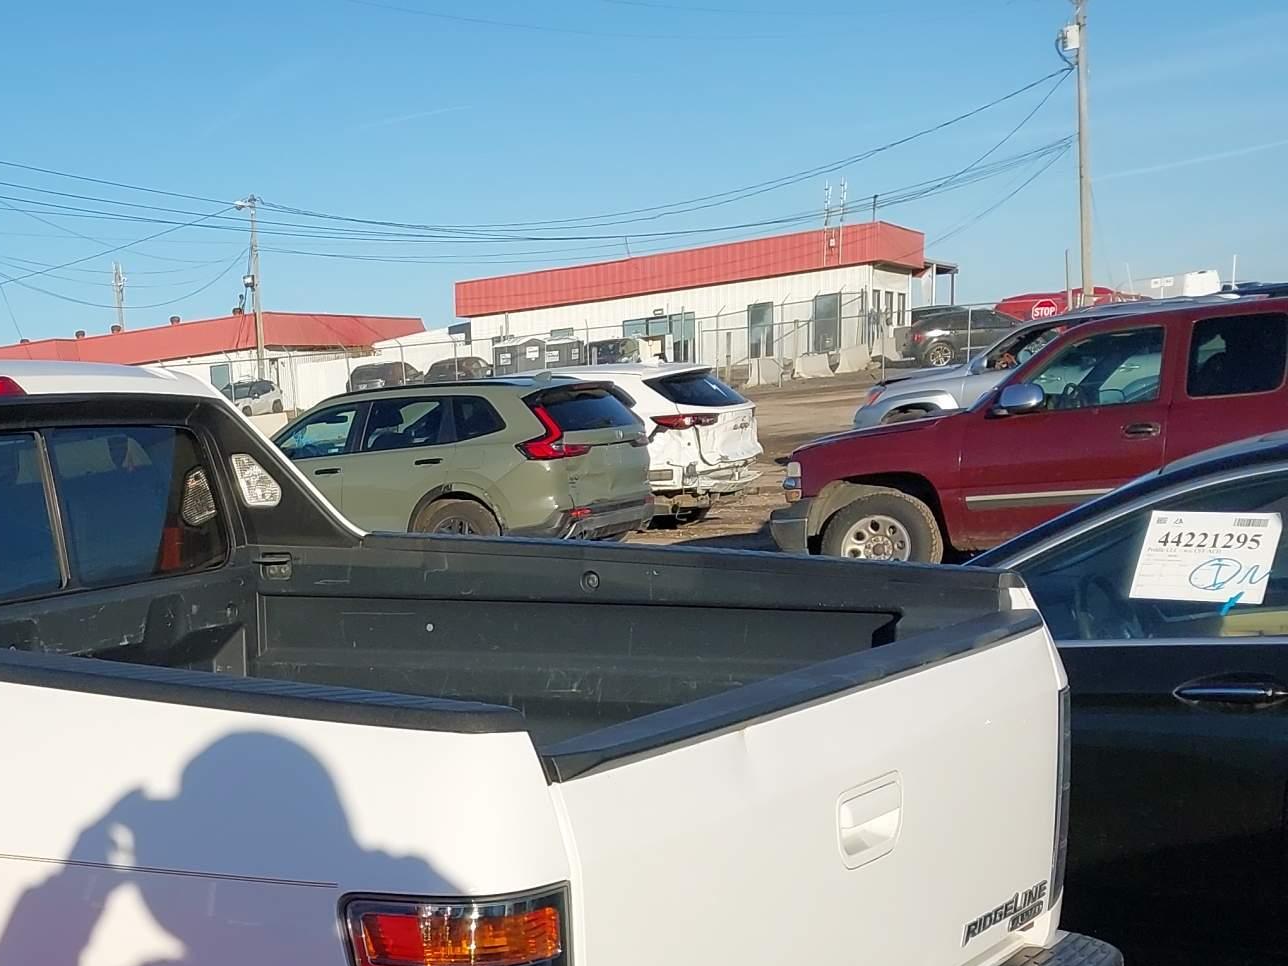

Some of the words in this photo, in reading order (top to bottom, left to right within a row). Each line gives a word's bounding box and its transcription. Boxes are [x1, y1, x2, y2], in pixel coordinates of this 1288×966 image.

[1034, 306, 1057, 317] STOP
[1157, 531, 1263, 550] 44221295
[962, 880, 1048, 946] RIDGELINE
